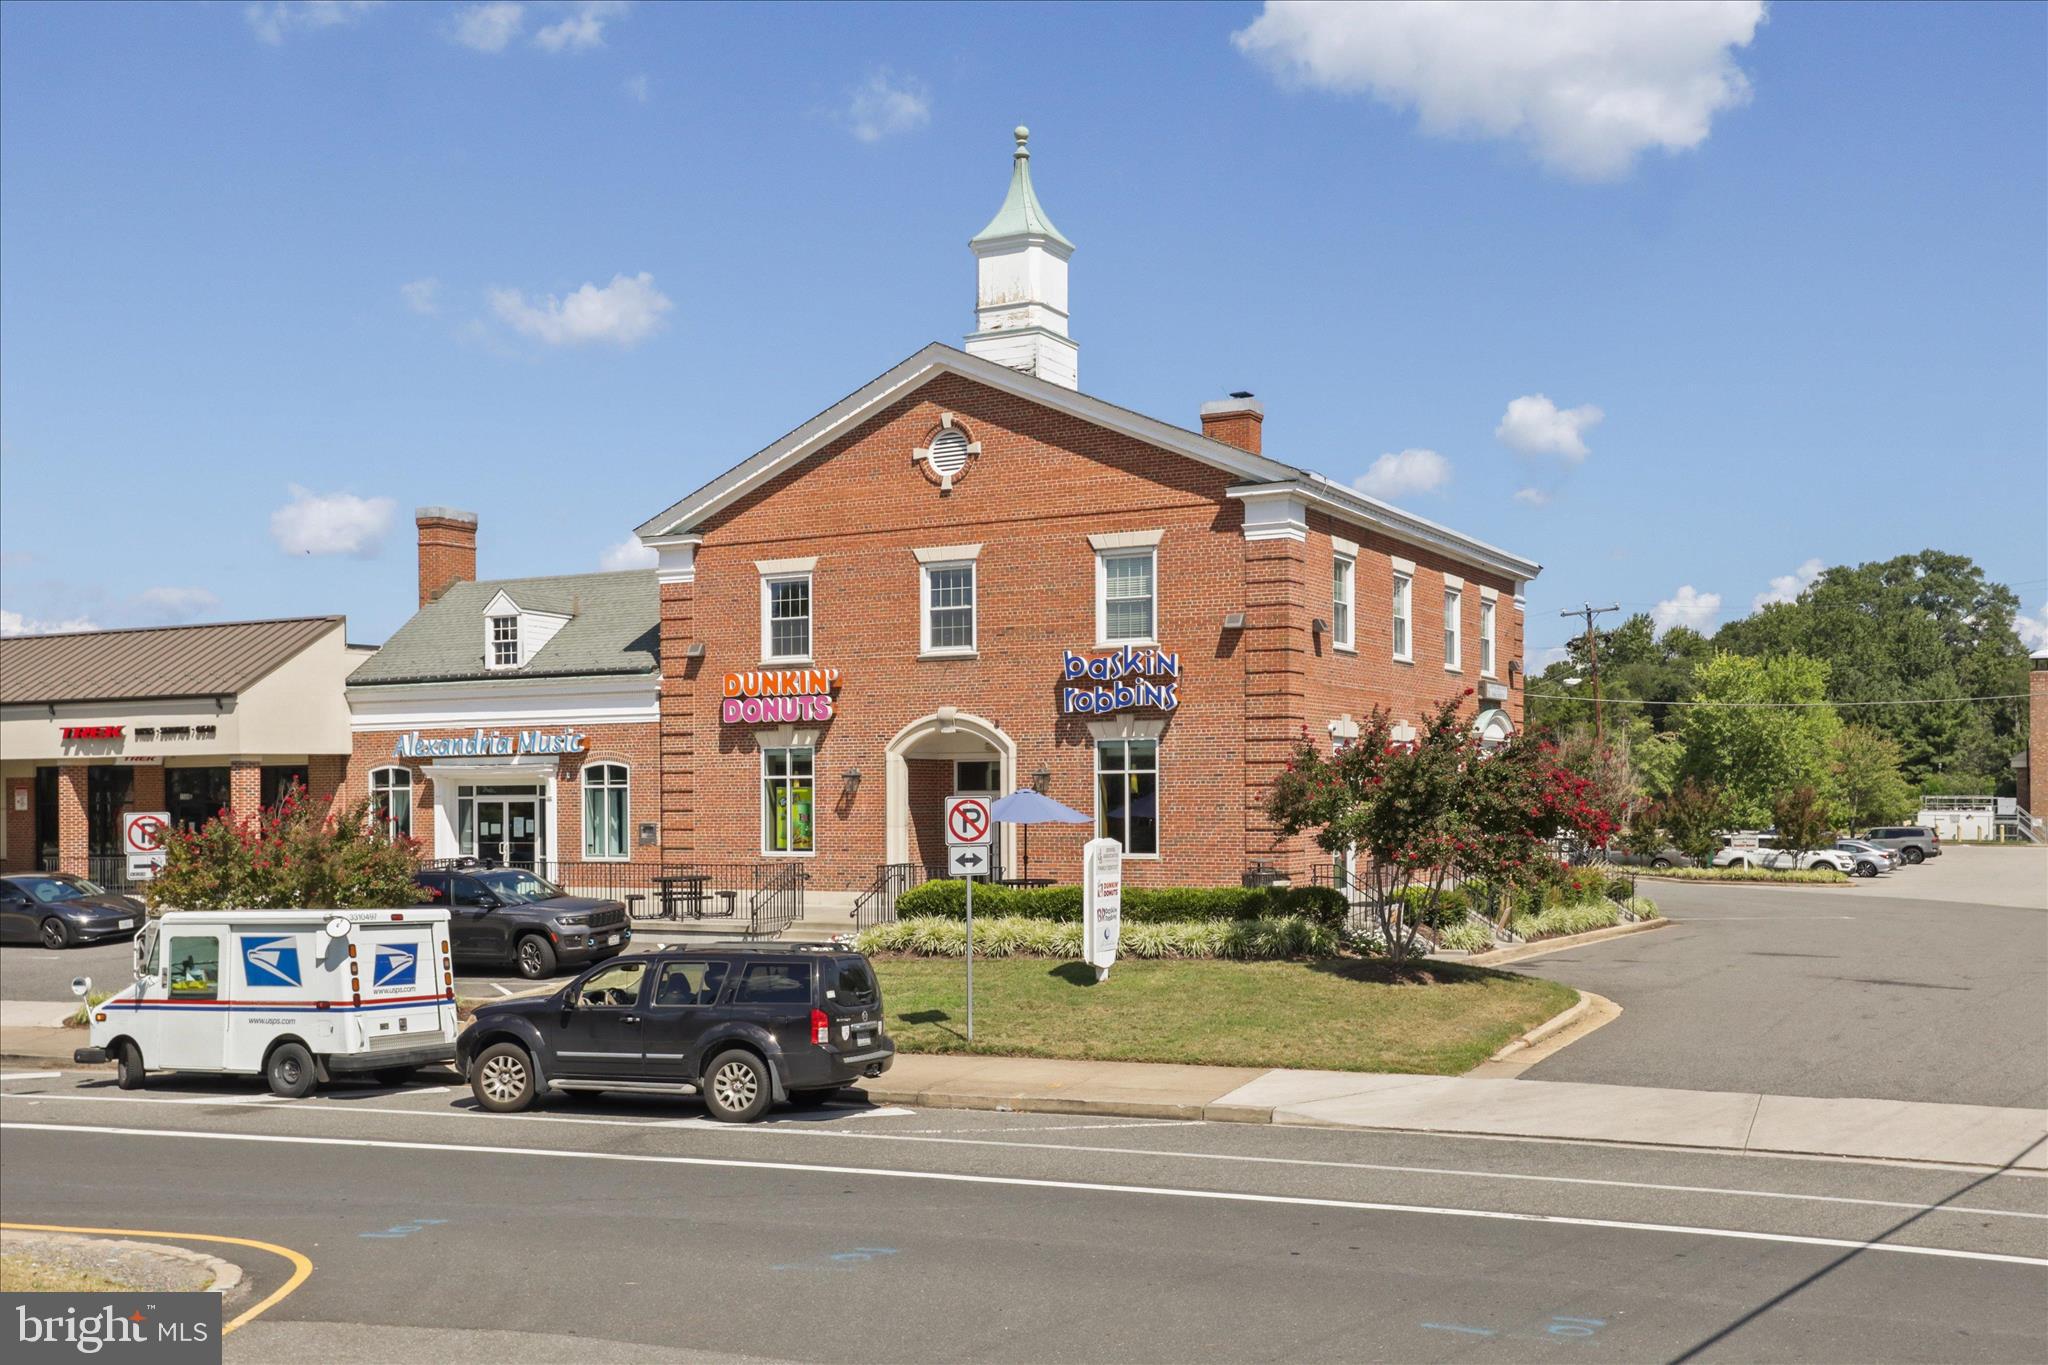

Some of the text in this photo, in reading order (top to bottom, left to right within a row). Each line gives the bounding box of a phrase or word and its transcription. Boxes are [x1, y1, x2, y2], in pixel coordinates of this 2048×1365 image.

[722, 669, 839, 697] DUNKIN'
[722, 695, 833, 723] DONUTS
[59, 725, 127, 739] TREK
[392, 728, 586, 757] Alexandria Music
[248, 1018, 296, 1026] www.usps.com
